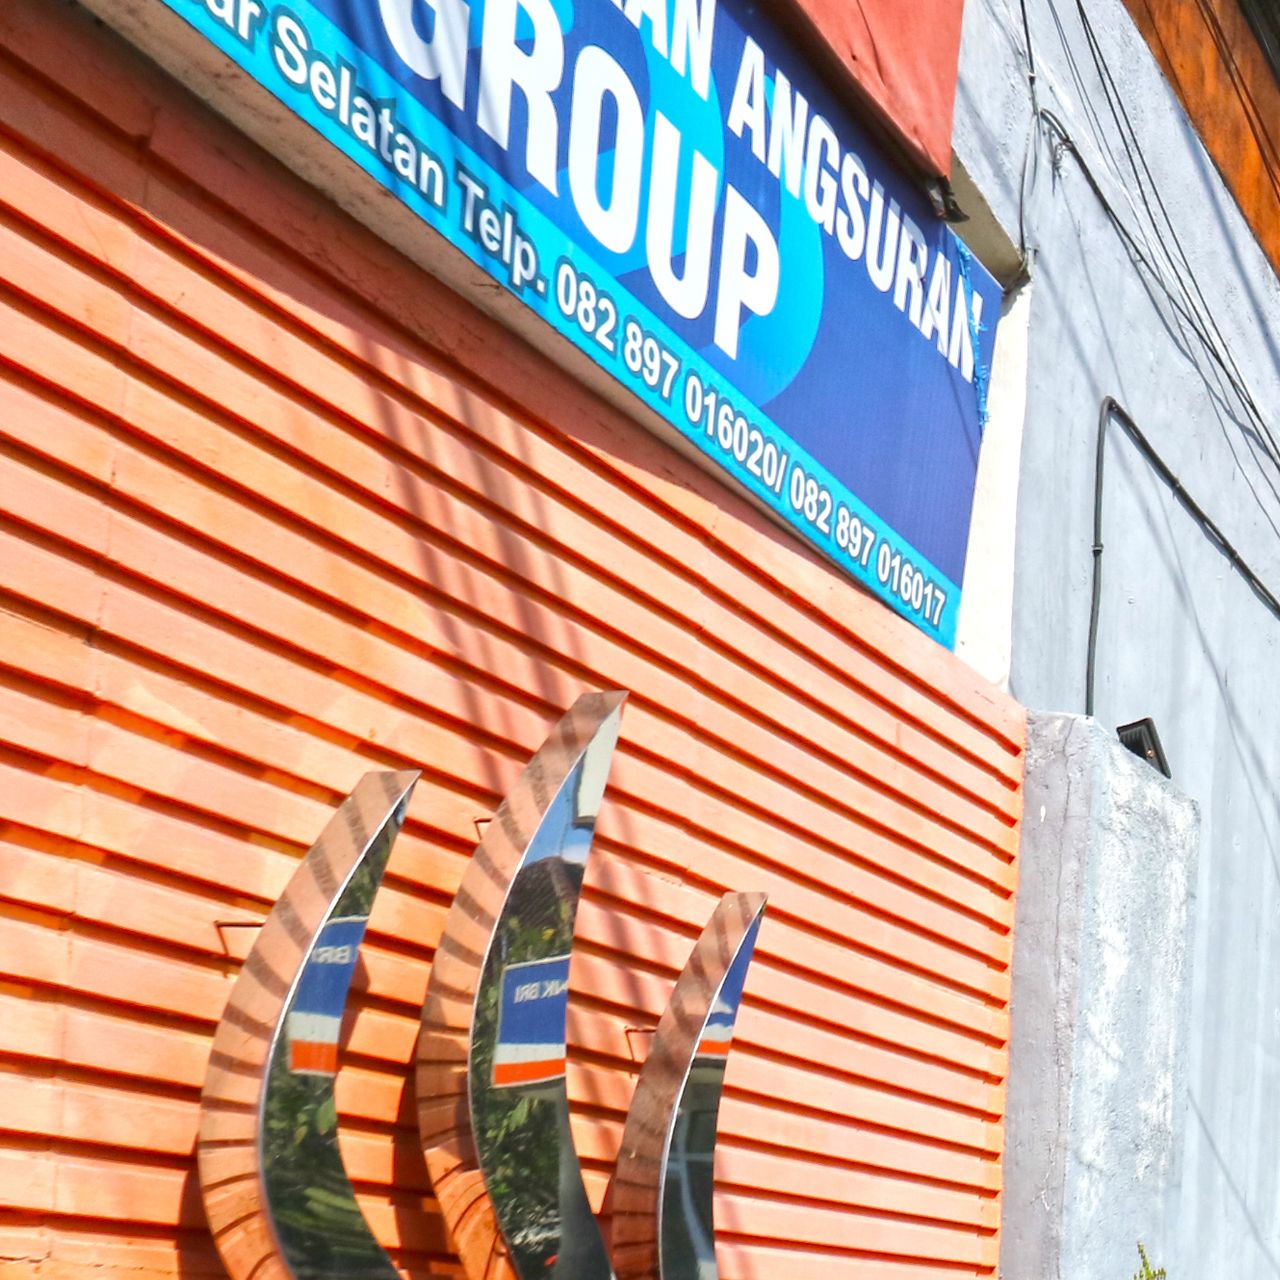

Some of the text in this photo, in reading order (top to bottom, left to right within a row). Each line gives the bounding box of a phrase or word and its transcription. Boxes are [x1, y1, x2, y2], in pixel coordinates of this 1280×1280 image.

[273, 15, 446, 208] Selatan
[457, 170, 546, 293] Telp.
[556, 263, 617, 352] 082
[624, 321, 679, 398] 897
[685, 375, 788, 494] 016020/
[789, 466, 832, 534] 082
[836, 507, 875, 567] 897
[878, 543, 947, 626] 016017
[378, 0, 780, 360] GROUP
[608, 0, 983, 384] AN ANGSURAN
